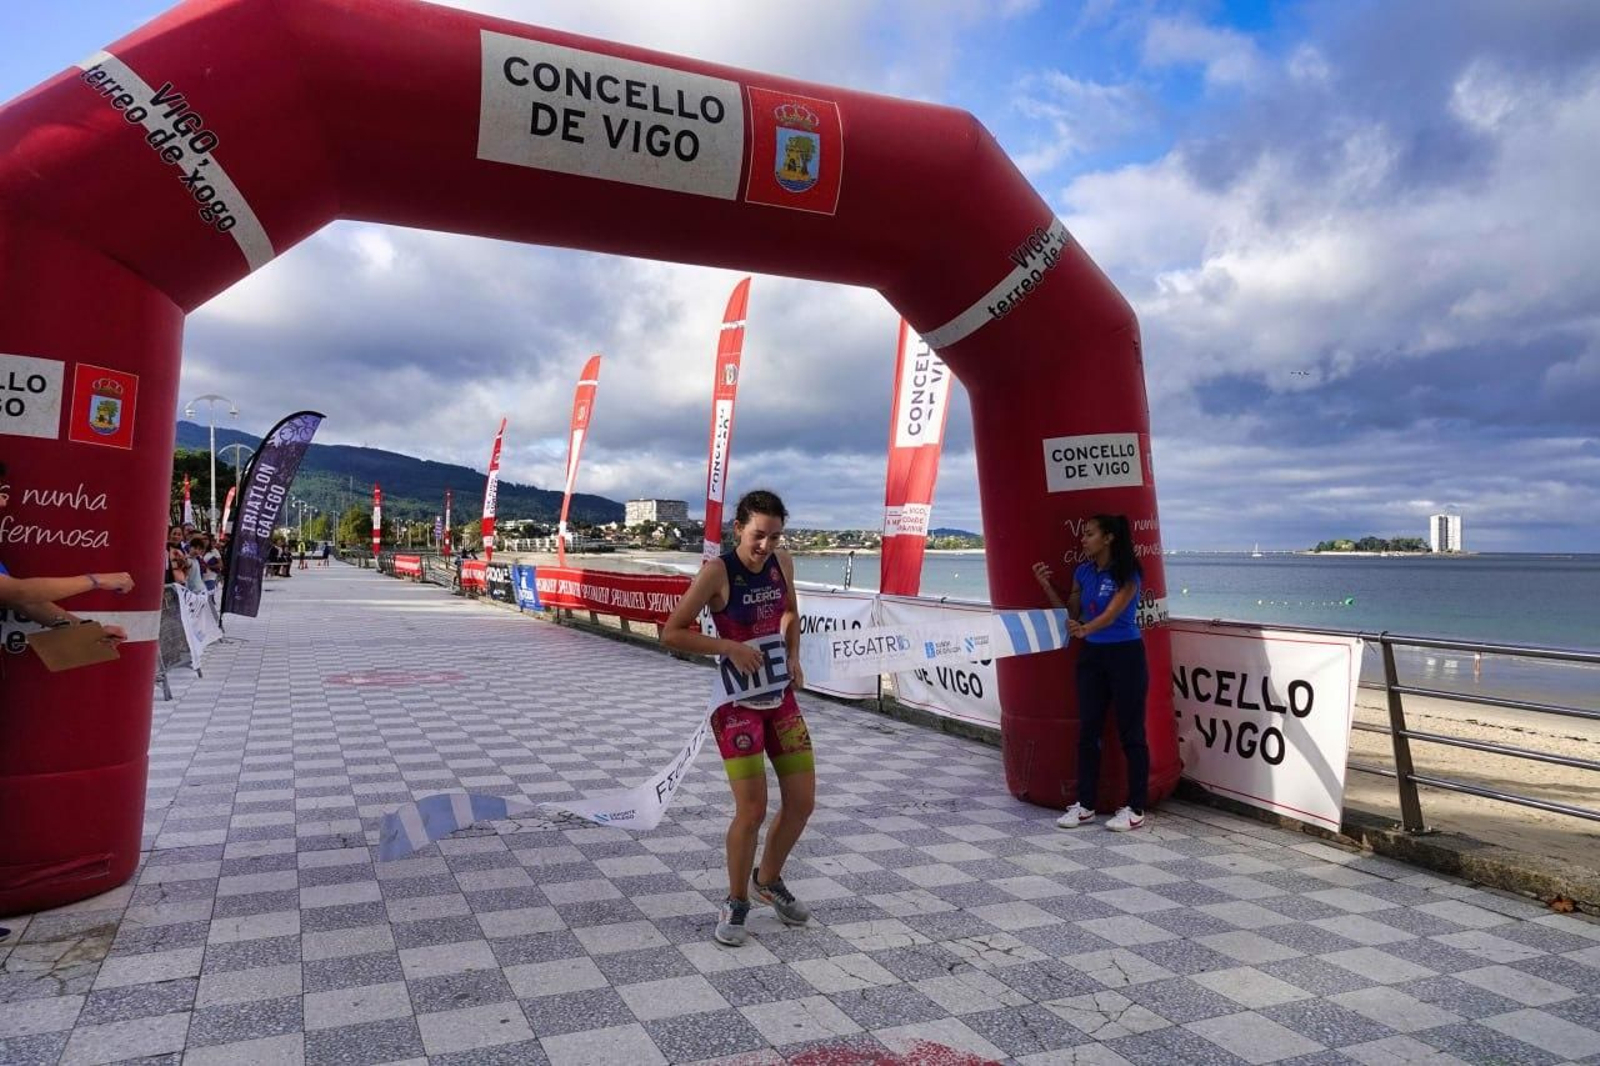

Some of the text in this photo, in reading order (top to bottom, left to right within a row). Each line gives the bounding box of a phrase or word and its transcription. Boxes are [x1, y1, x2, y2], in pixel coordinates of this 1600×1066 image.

[503, 56, 725, 124] CONCELLO
[81, 63, 236, 232] terreo de xogo
[530, 101, 700, 163] DE VIGO
[987, 246, 1061, 319] terreo de
[1052, 444, 1136, 463] CONCELLO
[1065, 461, 1130, 479] DE VIGO
[21, 482, 108, 511] nunha
[241, 462, 276, 533] TRIATLON
[256, 484, 287, 539] GALEGO
[0, 515, 110, 549] fermosa
[936, 665, 984, 698] VIGO
[1195, 715, 1285, 765] VIGO
